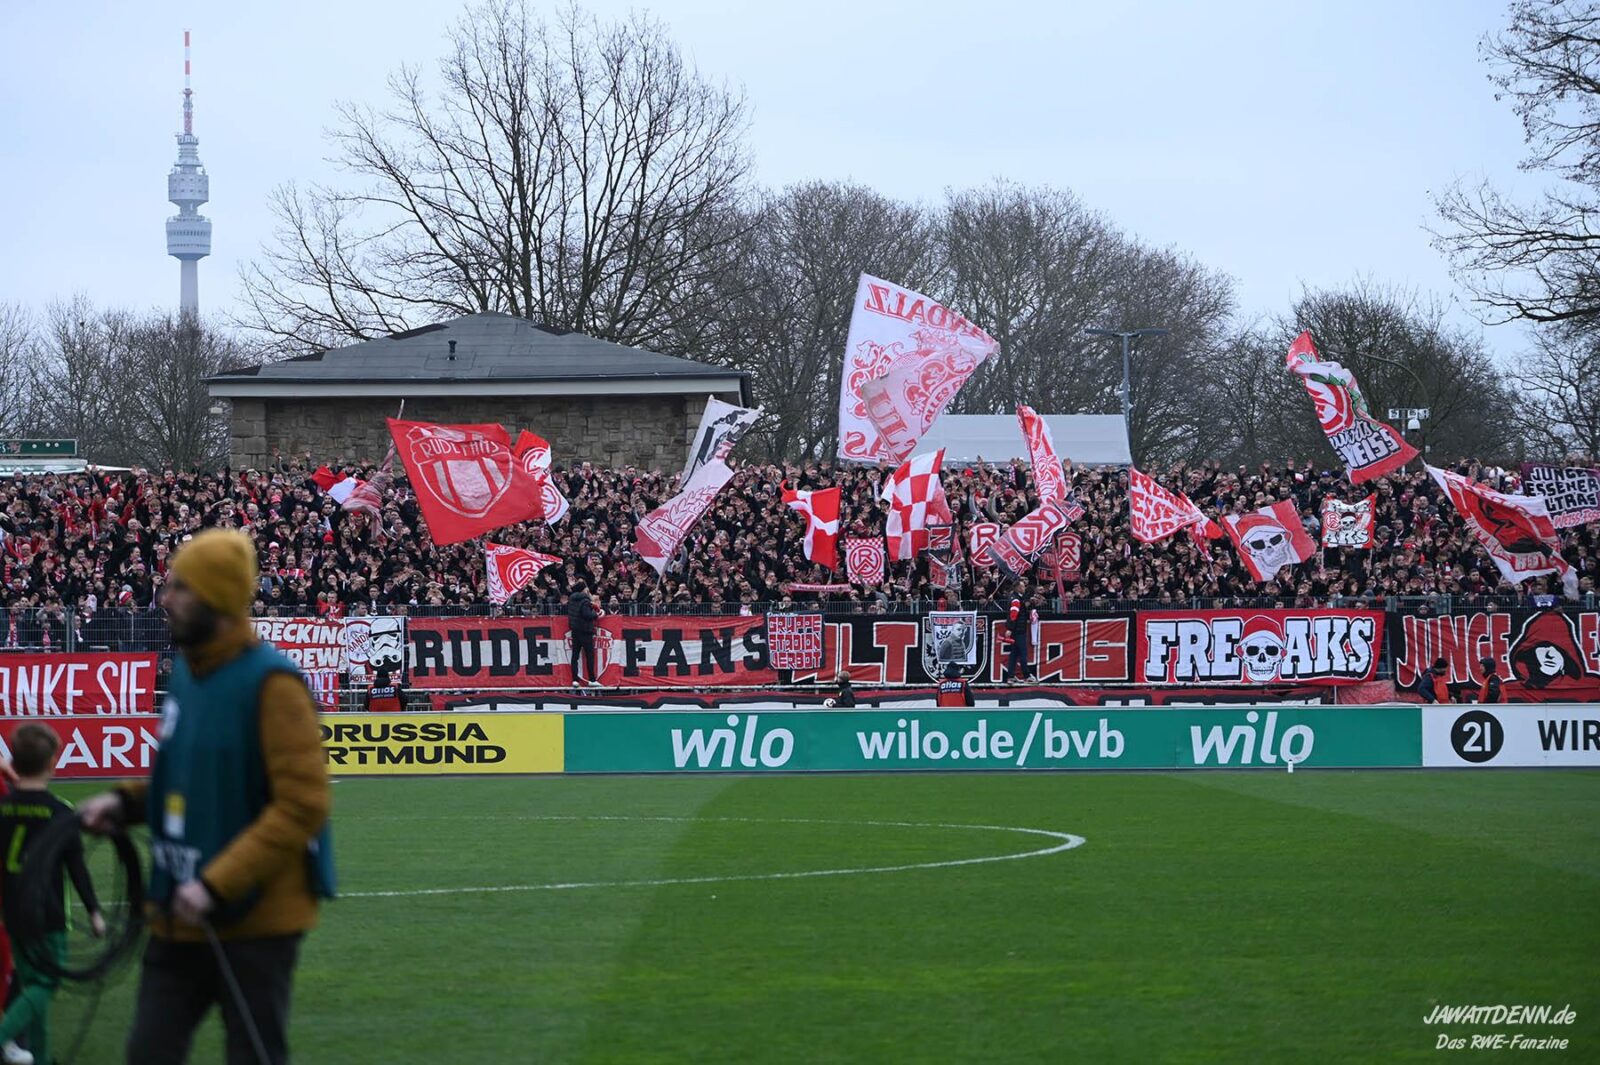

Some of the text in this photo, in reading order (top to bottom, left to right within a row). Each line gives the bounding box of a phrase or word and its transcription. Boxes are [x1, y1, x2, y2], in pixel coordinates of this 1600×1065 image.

[1525, 478, 1599, 497] ESSENER
[1531, 467, 1588, 482] JUNGE
[1544, 493, 1598, 512] LTRAS
[250, 621, 348, 645] RECKING
[768, 615, 822, 633] GRUPPE
[410, 626, 768, 677] RUDE FANS
[769, 633, 822, 651] STADION
[1396, 612, 1517, 687] JUNGE
[770, 651, 822, 669] VERBOT
[96, 661, 151, 716] SIE
[670, 714, 795, 768] wilo
[856, 712, 1125, 766] wilo.de/bvb
[1190, 710, 1315, 765] wilo
[1462, 721, 1492, 752] 21
[1537, 719, 1600, 751] WIR
